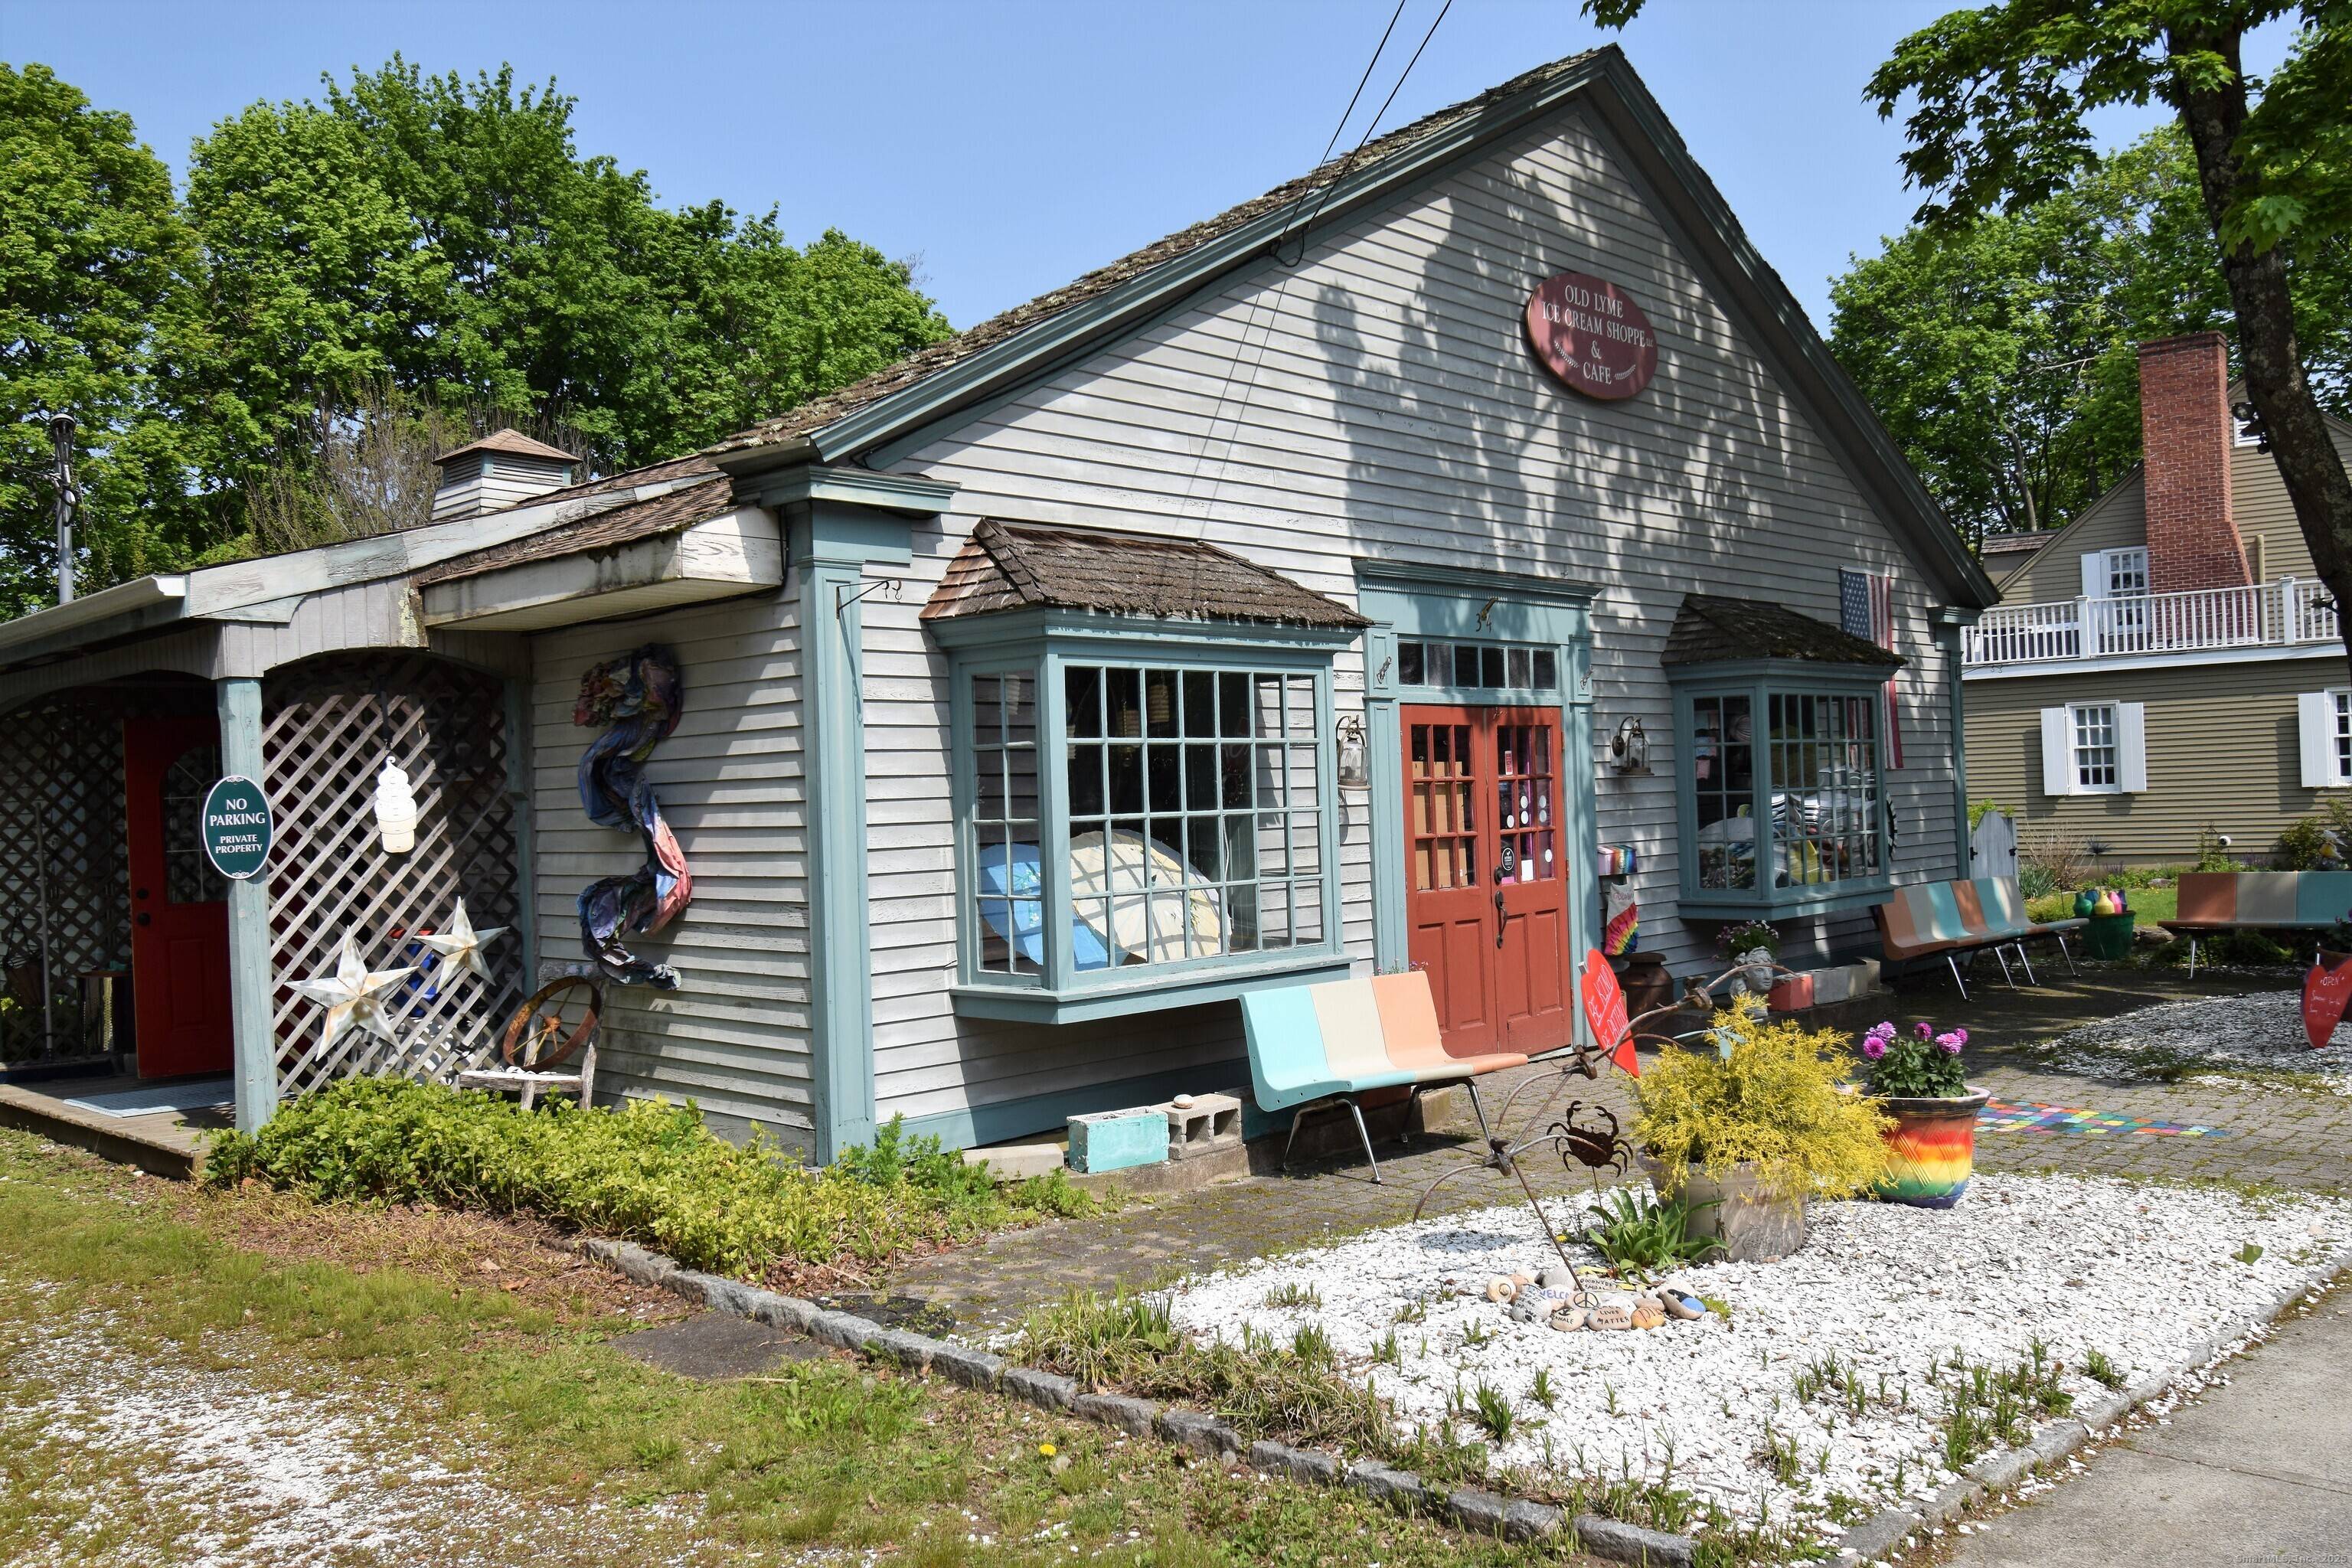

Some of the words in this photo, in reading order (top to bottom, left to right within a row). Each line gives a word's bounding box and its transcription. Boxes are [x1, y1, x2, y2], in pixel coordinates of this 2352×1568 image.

[1565, 284, 1589, 308] OLD
[1594, 292, 1623, 318] LYME
[1542, 301, 1560, 323] ICE
[1564, 308, 1602, 335] CREAM
[1606, 320, 1645, 348] SHOPPE
[1591, 340, 1602, 359] &
[1583, 361, 1612, 385] CAFE
[226, 798, 247, 811] NO
[210, 812, 266, 827] PARKING
[220, 834, 258, 844] PRIVATE
[215, 844, 263, 854] PROPERTY
[1593, 964, 1613, 1008] KIND
[1597, 1316, 1630, 1325] MATTER
